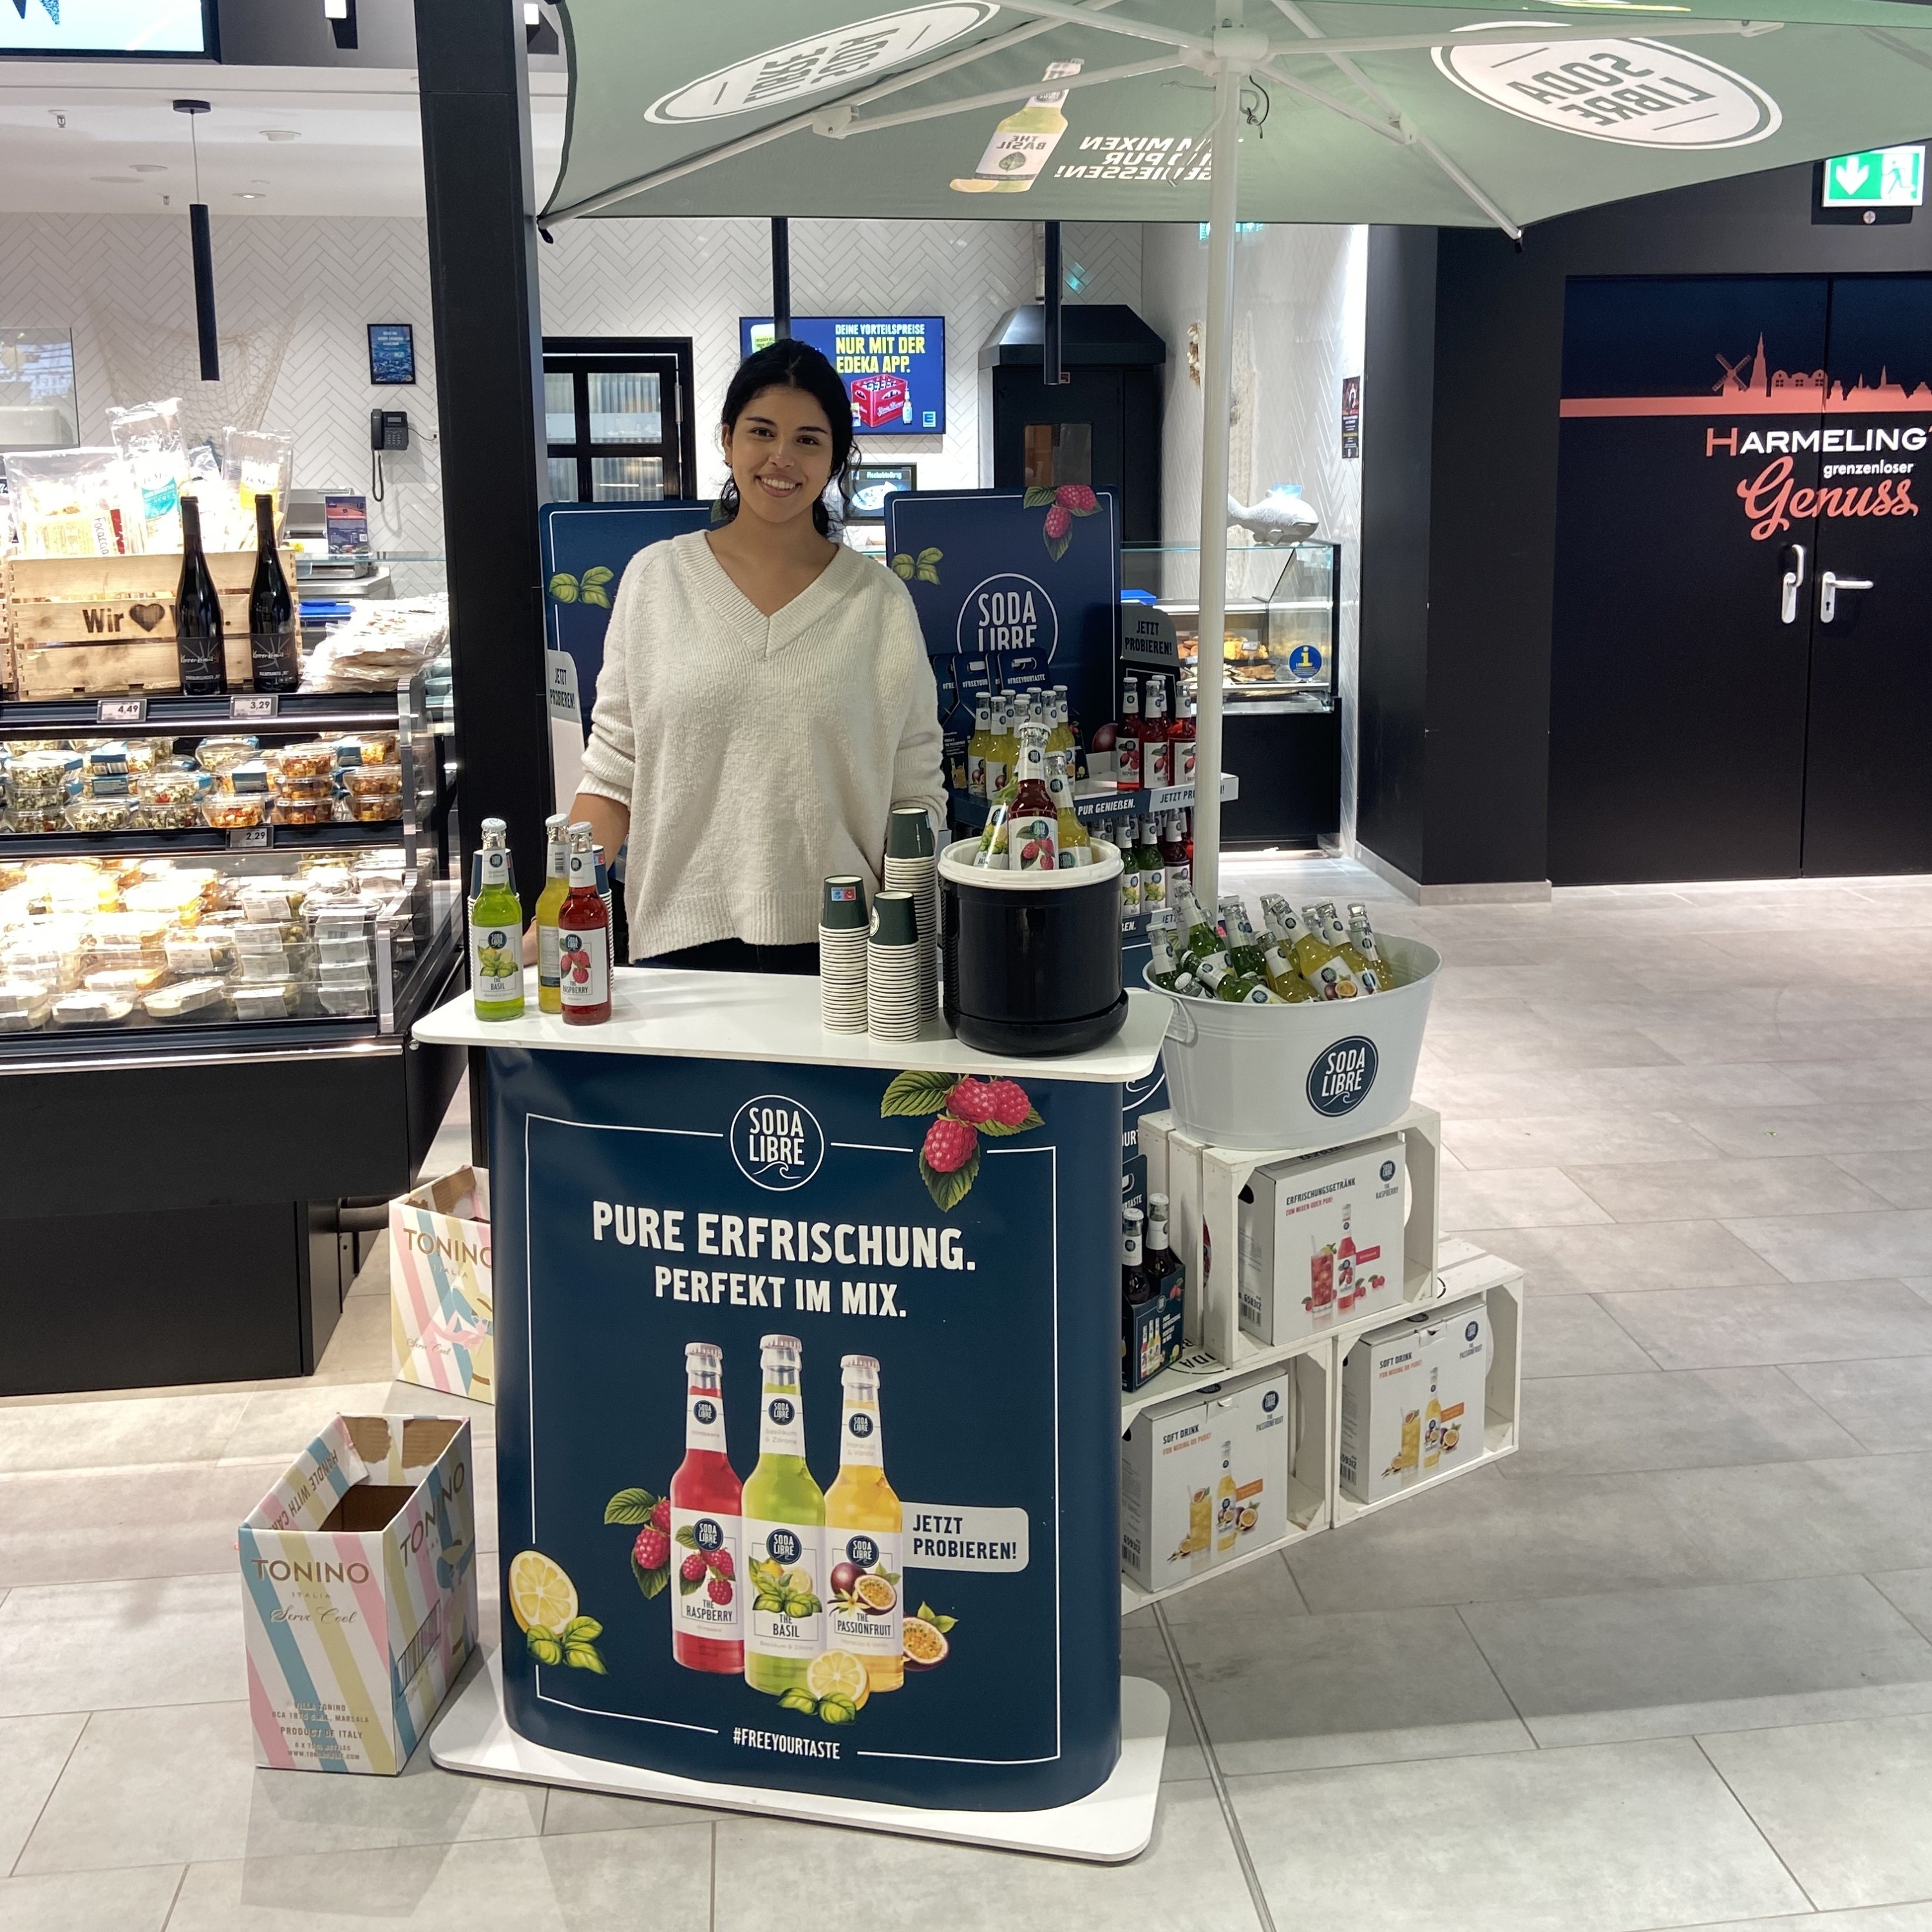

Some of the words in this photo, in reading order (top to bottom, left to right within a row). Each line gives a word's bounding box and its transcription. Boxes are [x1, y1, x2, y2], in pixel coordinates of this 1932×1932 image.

[835, 324, 858, 335] DEINE
[860, 324, 925, 335] VORTEILSPREISE
[836, 336, 866, 354] NUR
[869, 336, 895, 354] MIT
[898, 336, 925, 354] DER
[837, 355, 878, 374] EDEKA
[882, 355, 911, 374] APP.
[1823, 459, 1914, 478] grenzenloser
[1736, 455, 1918, 541] Genuss
[978, 591, 1037, 627] SODA
[82, 608, 124, 633] Wir
[1136, 620, 1159, 635] JETZT
[1124, 638, 1173, 656] PROBIEREN!
[118, 705, 138, 714] 4,49
[250, 701, 270, 710] 3,29
[1077, 804, 1094, 816] PUR
[1160, 791, 1181, 804] JETZT
[245, 831, 265, 840] 2,29
[1325, 1047, 1366, 1075] SODA
[1321, 1069, 1365, 1097] LIBRE
[749, 1106, 804, 1138] SODA
[748, 1134, 806, 1166] LIBRE
[1286, 1177, 1356, 1206] ERFRISCHUNGSGETRÄNK
[592, 1200, 686, 1252] PURE
[697, 1213, 976, 1271] ERFRISCHUNG.
[654, 1265, 786, 1308] PERFEKT
[795, 1278, 831, 1312] IM
[841, 1281, 907, 1318] MIX.
[1379, 1358, 1394, 1368] SOFT
[1395, 1352, 1412, 1364] DRINK
[773, 1402, 789, 1411] SODA
[773, 1410, 790, 1419] LIBRE
[853, 1416, 868, 1425] SODA
[853, 1423, 869, 1432] LIBRE
[765, 1428, 797, 1437] Basilikum
[1163, 1431, 1179, 1444] SOFT
[1180, 1424, 1199, 1438] DRINK
[308, 1449, 339, 1492] HANDLE
[288, 1484, 310, 1517] WITH
[269, 1510, 289, 1530] CA
[913, 1514, 963, 1535] JETZT
[699, 1522, 717, 1536] SODA
[699, 1532, 717, 1545] LIBRE
[773, 1533, 794, 1547] SODA
[853, 1538, 872, 1551] SODA
[773, 1544, 795, 1556] LIBRE
[853, 1548, 873, 1560] LIBRE
[913, 1538, 1018, 1560] PROBIEREN!
[251, 1559, 369, 1584] TONINO
[703, 1599, 714, 1609] THE
[270, 1605, 311, 1623] Serve
[316, 1606, 357, 1624] Cool
[686, 1605, 733, 1622] RASPBERRY
[779, 1613, 793, 1624] THE
[857, 1613, 869, 1622] THE
[772, 1623, 800, 1638] BASIL
[837, 1620, 891, 1636] PASSIONFRUIT
[335, 1715, 369, 1723] MARSALA
[280, 1727, 322, 1738] PRODUCT
[339, 1730, 363, 1739] ITALY
[733, 1727, 840, 1760] #FREEYOURTASTE
